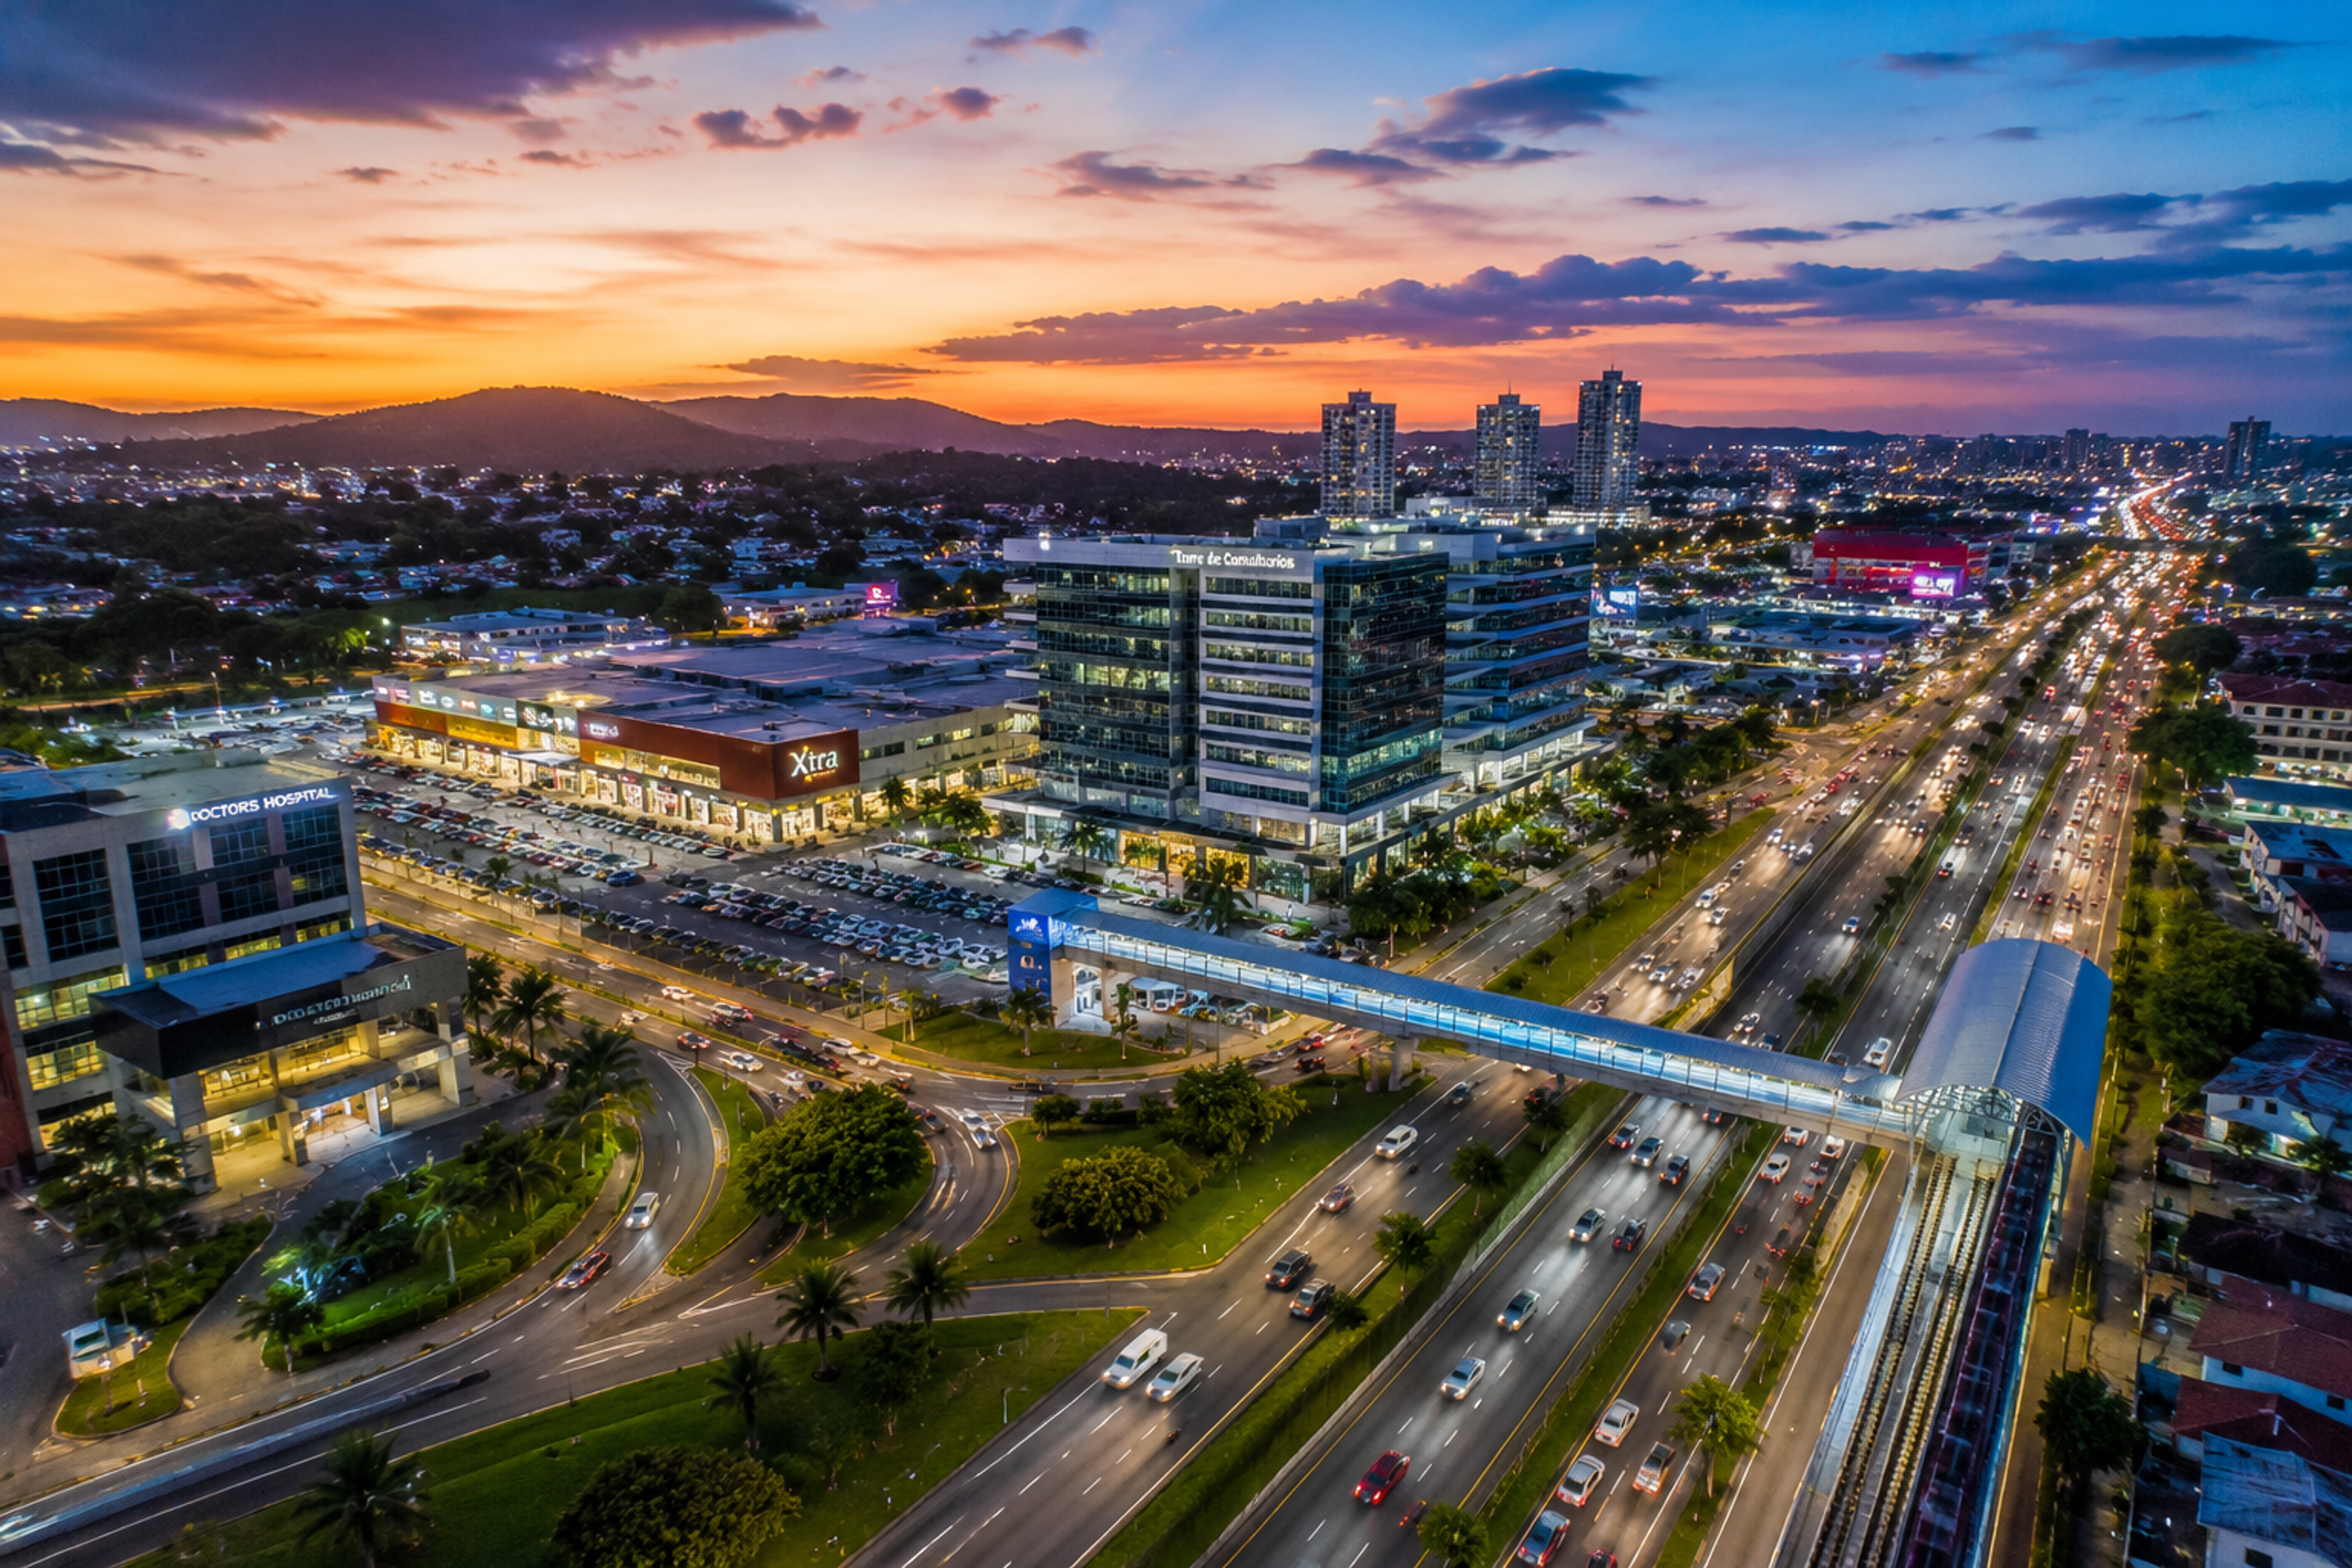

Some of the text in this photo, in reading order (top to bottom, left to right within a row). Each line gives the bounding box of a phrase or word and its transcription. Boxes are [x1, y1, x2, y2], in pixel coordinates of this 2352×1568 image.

[789, 745, 839, 777] Xtra
[190, 787, 336, 822] DOCTORS HOSPITAL
